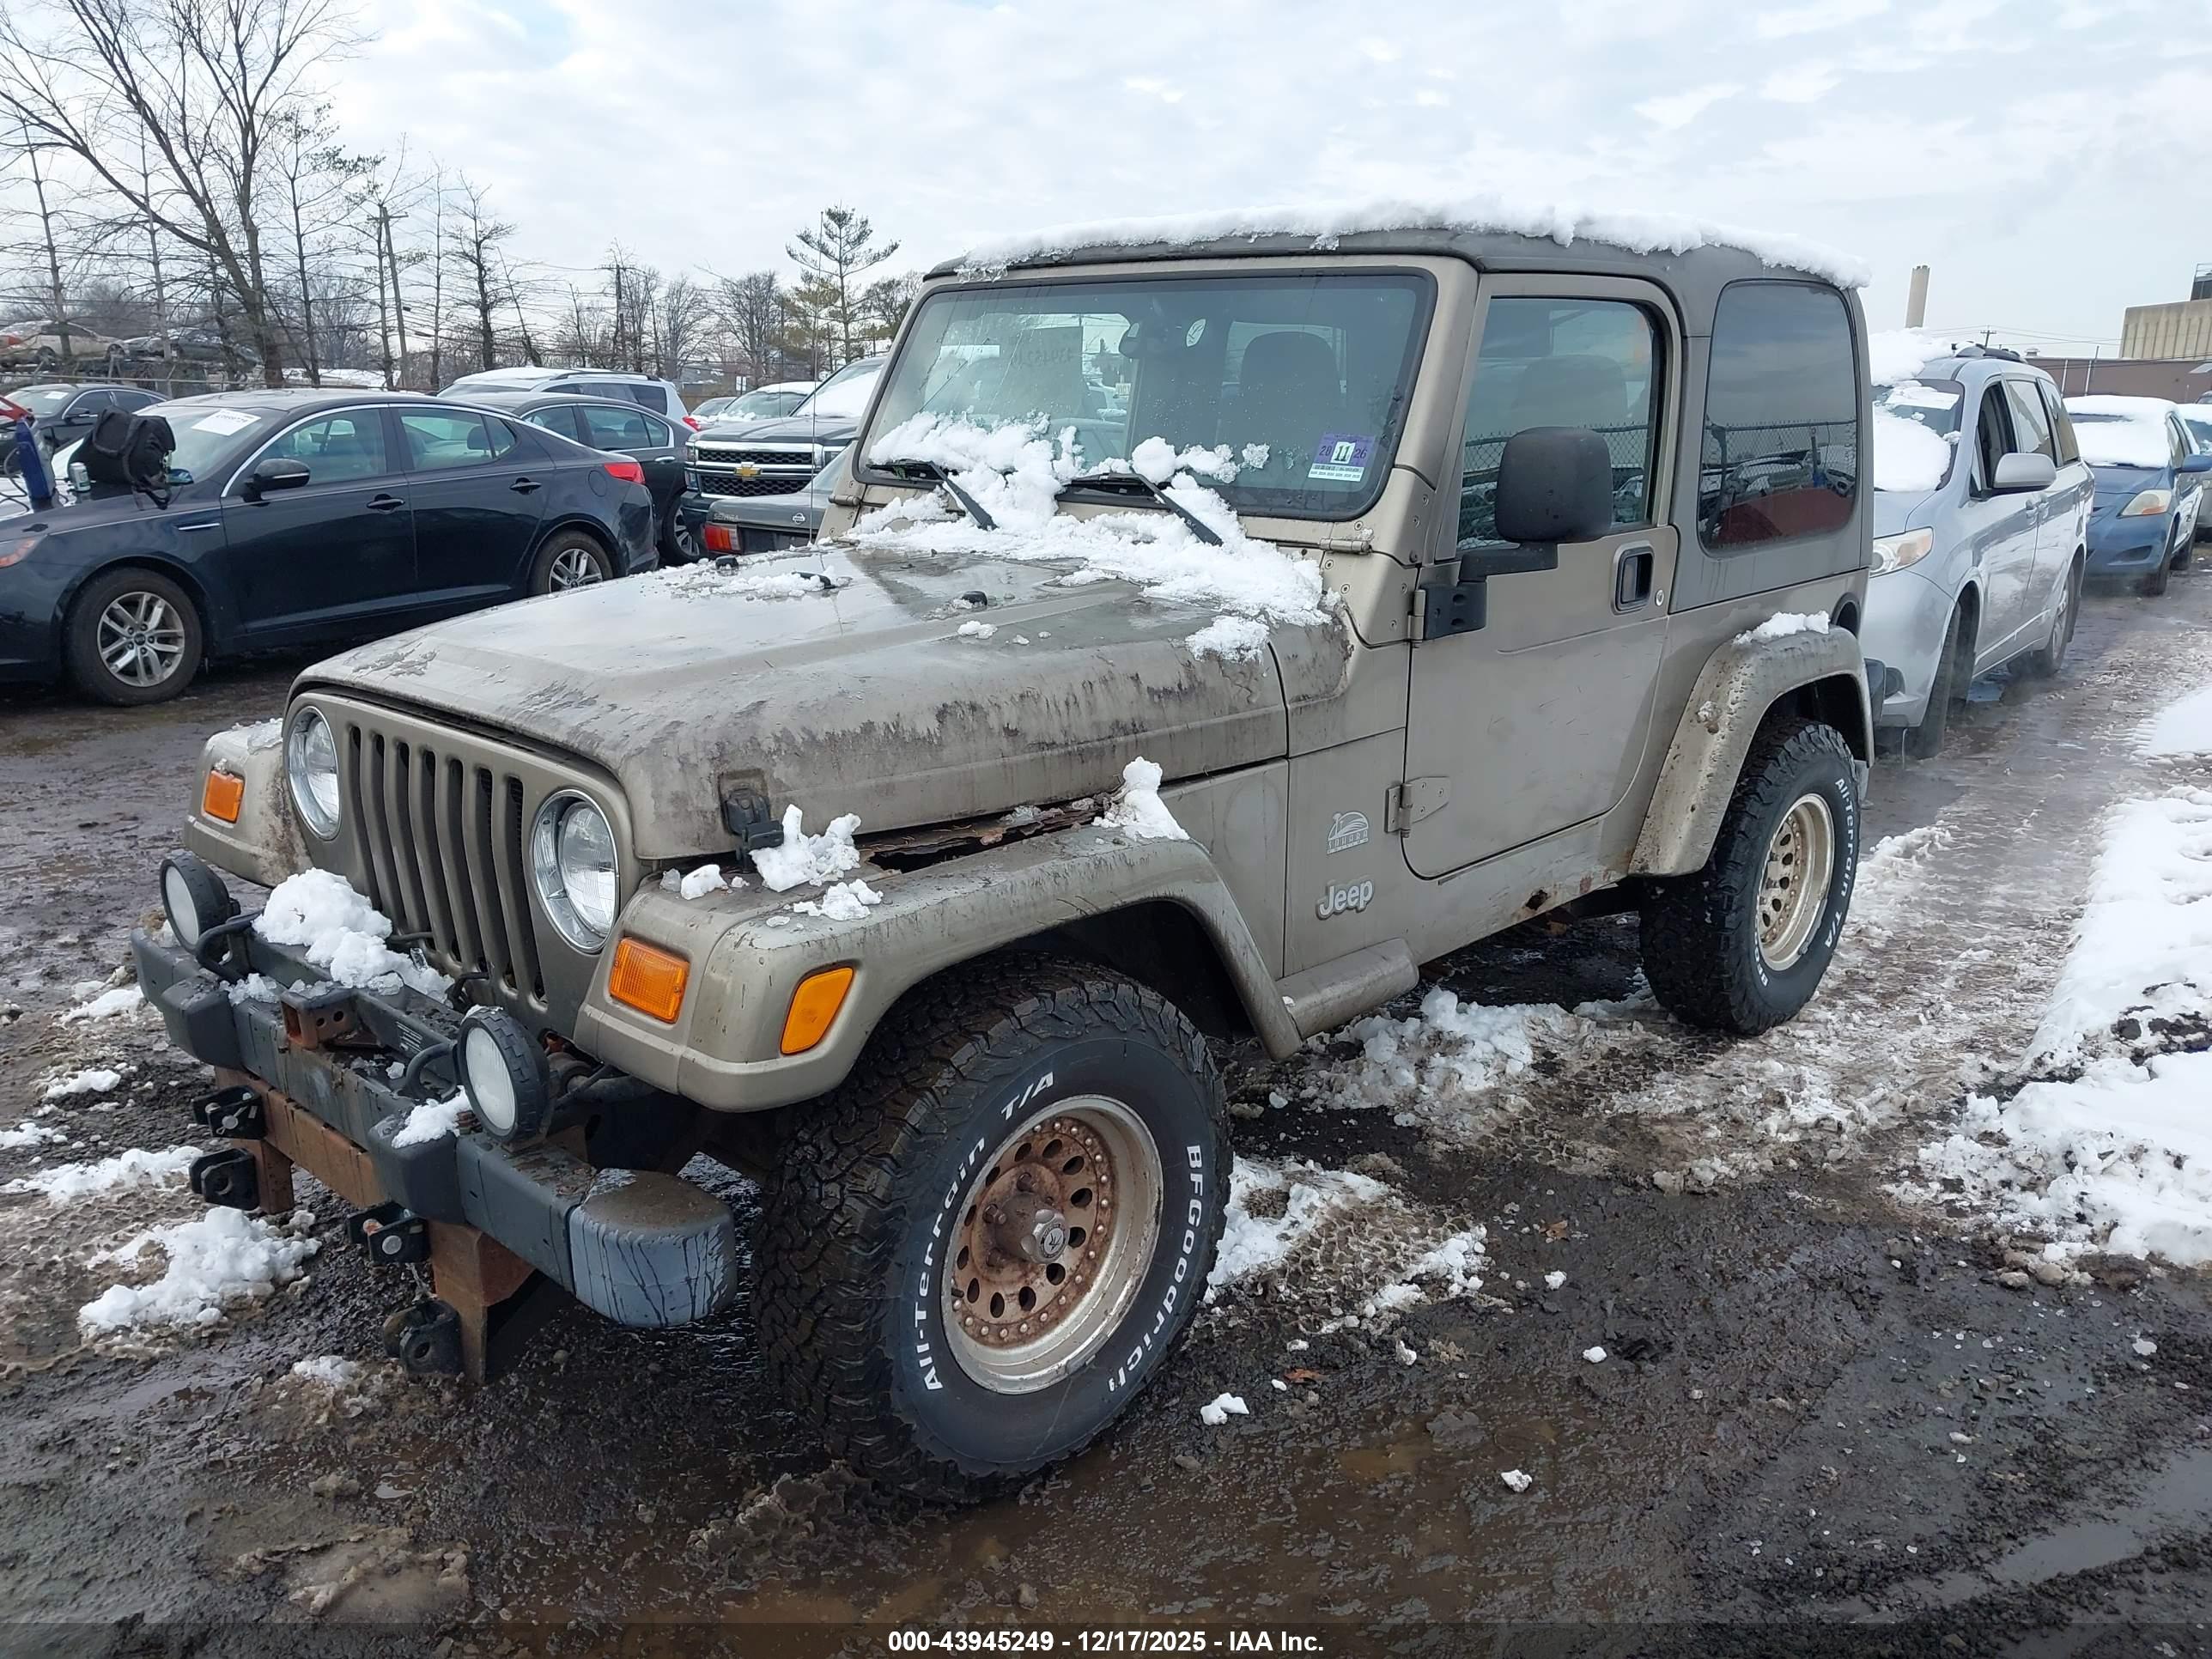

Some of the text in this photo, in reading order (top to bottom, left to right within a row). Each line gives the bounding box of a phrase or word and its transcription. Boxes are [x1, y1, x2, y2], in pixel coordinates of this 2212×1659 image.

[1320, 446, 1367, 461] 20 11 26
[1835, 778, 1854, 897] All-Terrain
[1319, 879, 1374, 916] Jeep
[1000, 1072, 1054, 1121] T/A
[914, 1136, 986, 1391] All-Terrain
[1108, 1145, 1203, 1392] BFGoodrich
